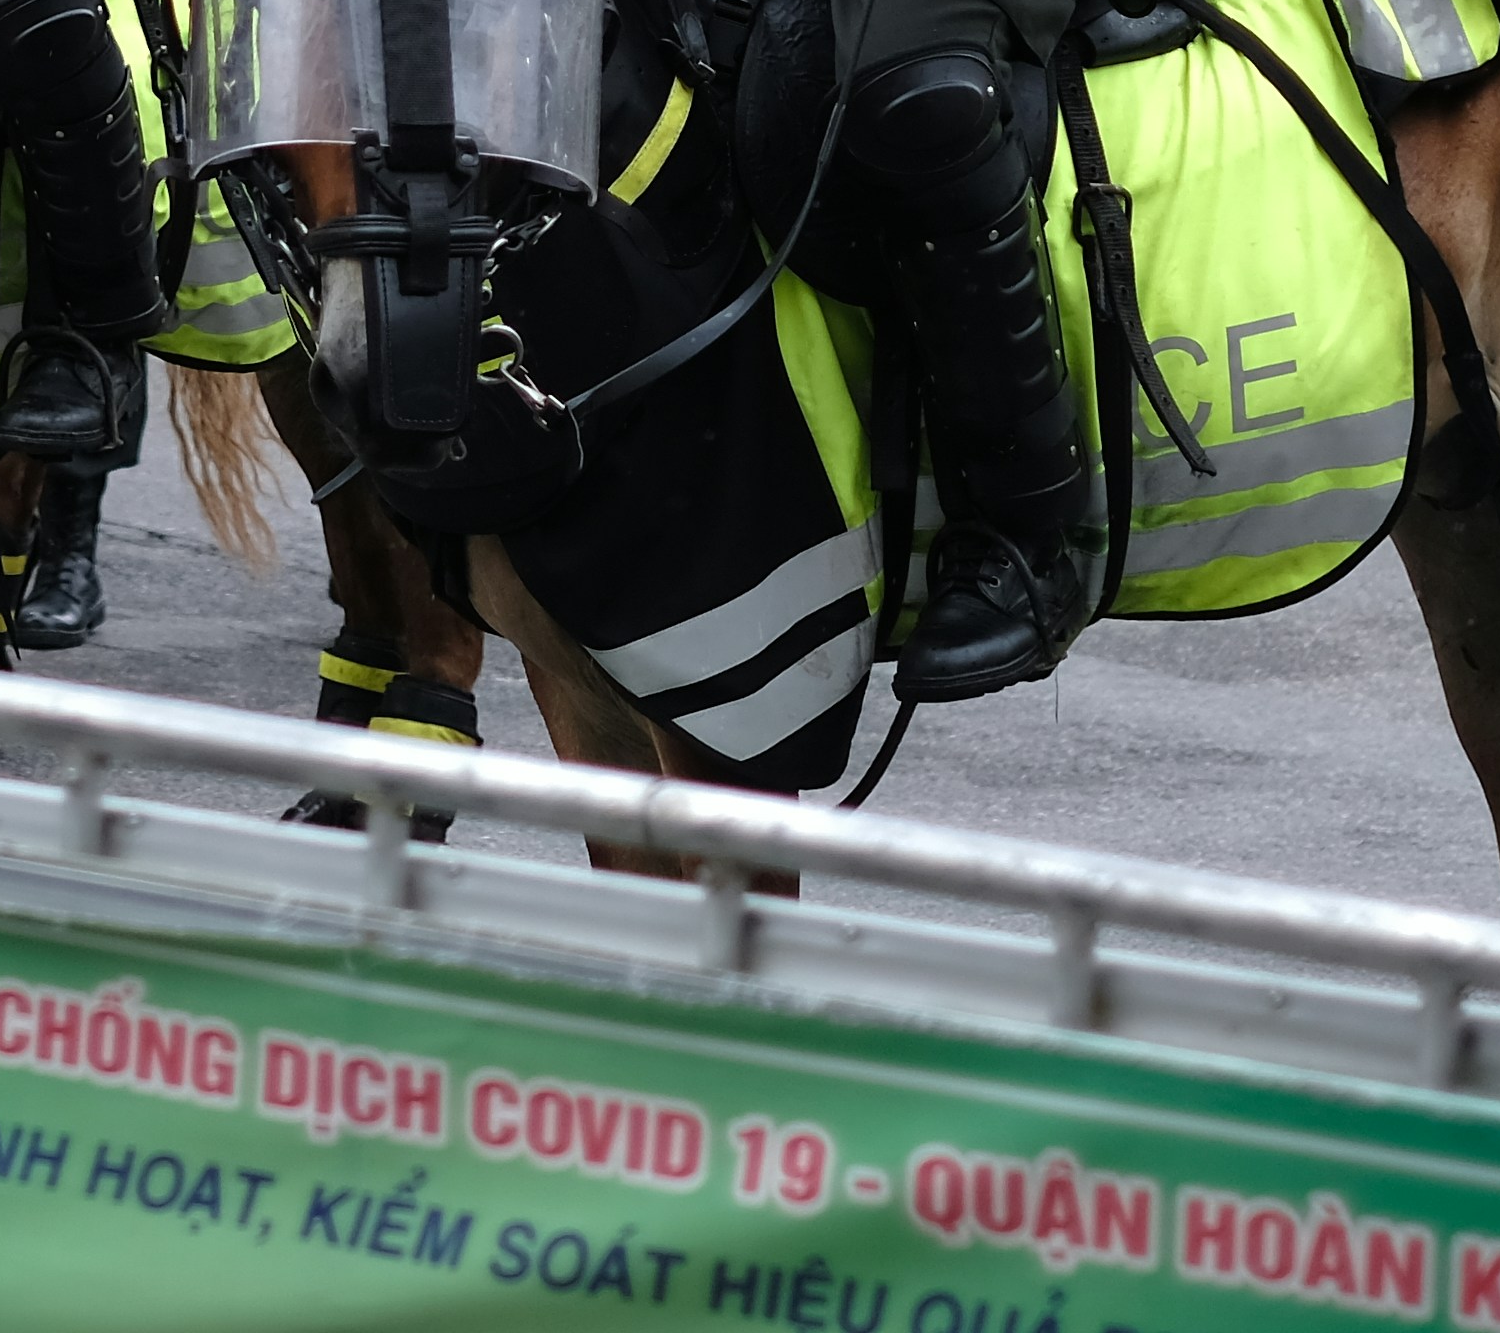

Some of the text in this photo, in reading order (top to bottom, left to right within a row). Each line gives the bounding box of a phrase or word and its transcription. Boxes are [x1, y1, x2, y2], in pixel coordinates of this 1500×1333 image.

[85, 1143, 275, 1244] HOẠT,
[300, 1166, 474, 1268] KIỂM
[488, 1221, 687, 1302] SOÁT
[261, 1037, 445, 1137] DỊCH
[469, 1076, 707, 1184] COVID
[735, 1122, 831, 1207] 19
[911, 1153, 1155, 1264] QUẬN
[1182, 1196, 1428, 1309] HOÀN
